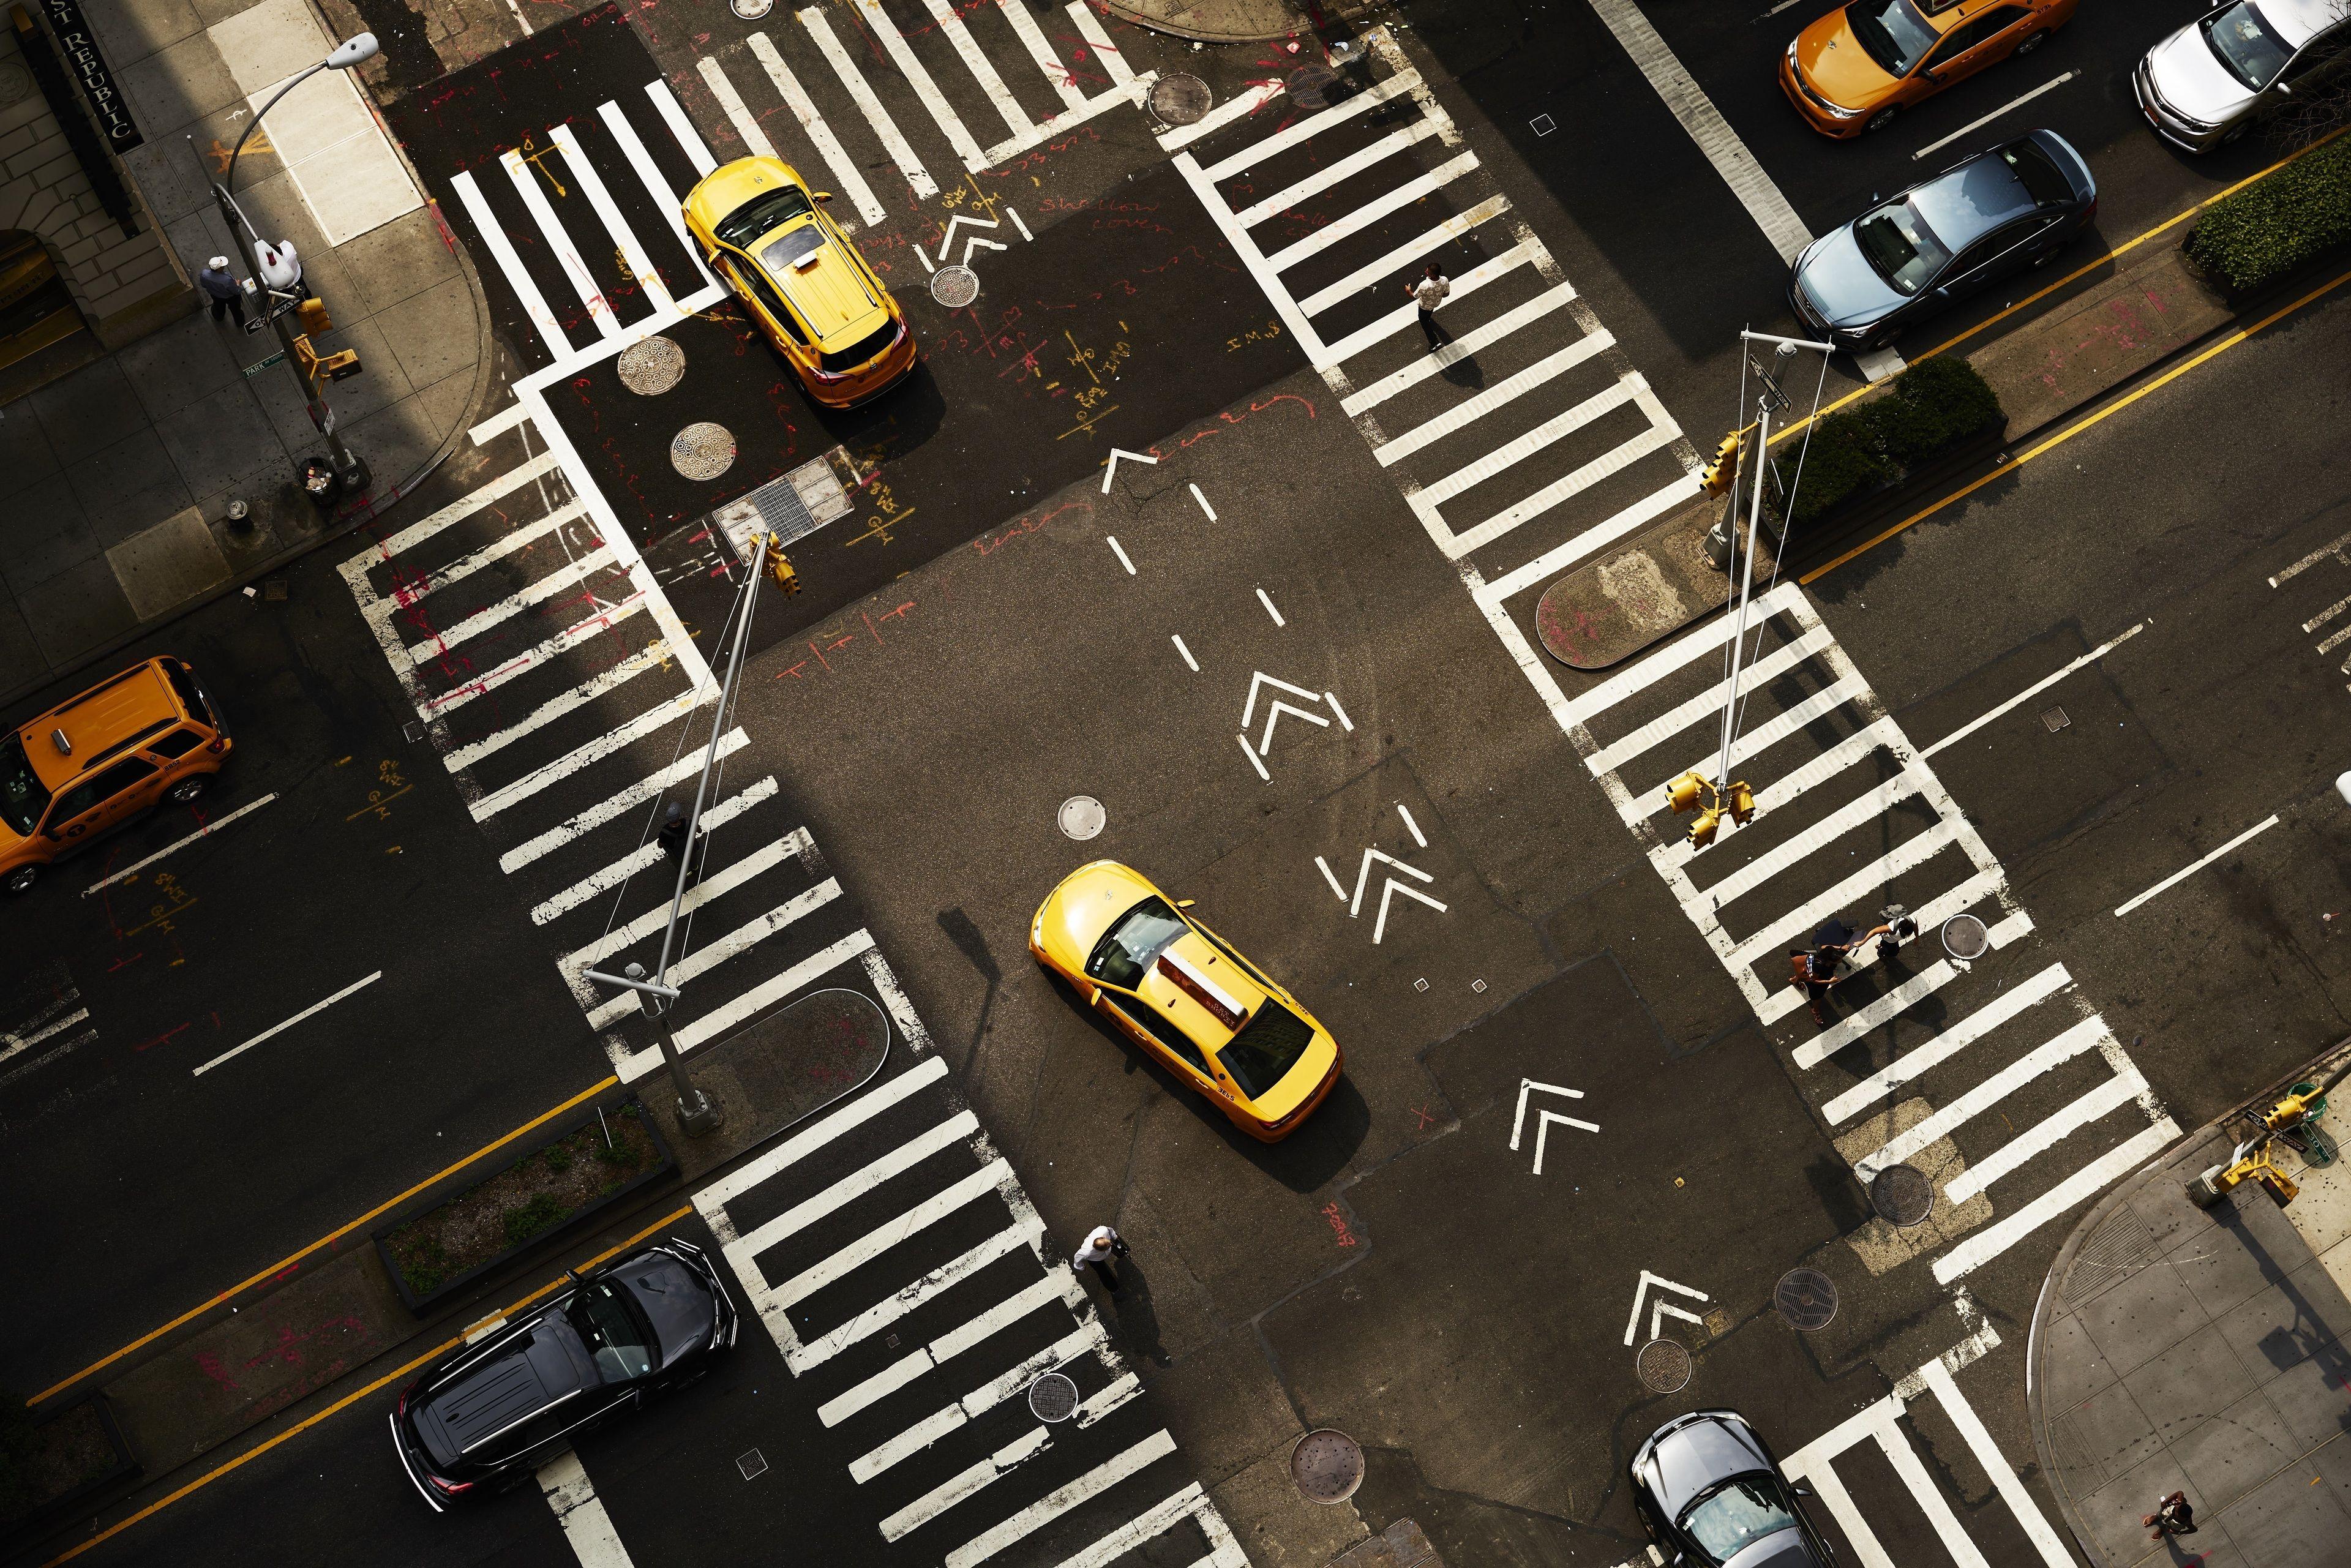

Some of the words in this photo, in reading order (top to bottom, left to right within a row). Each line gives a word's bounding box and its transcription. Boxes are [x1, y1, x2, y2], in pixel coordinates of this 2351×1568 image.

[62, 32, 130, 138] REPUBLIC
[278, 300, 297, 313] WAY
[246, 363, 264, 377] PARK
[1205, 1000, 1235, 1027] SHORTY
[1214, 1003, 1229, 1017] GET
[2282, 1135, 2303, 1150] WAY
[2301, 1122, 2308, 1131] E
[2308, 1134, 2320, 1148] 30
